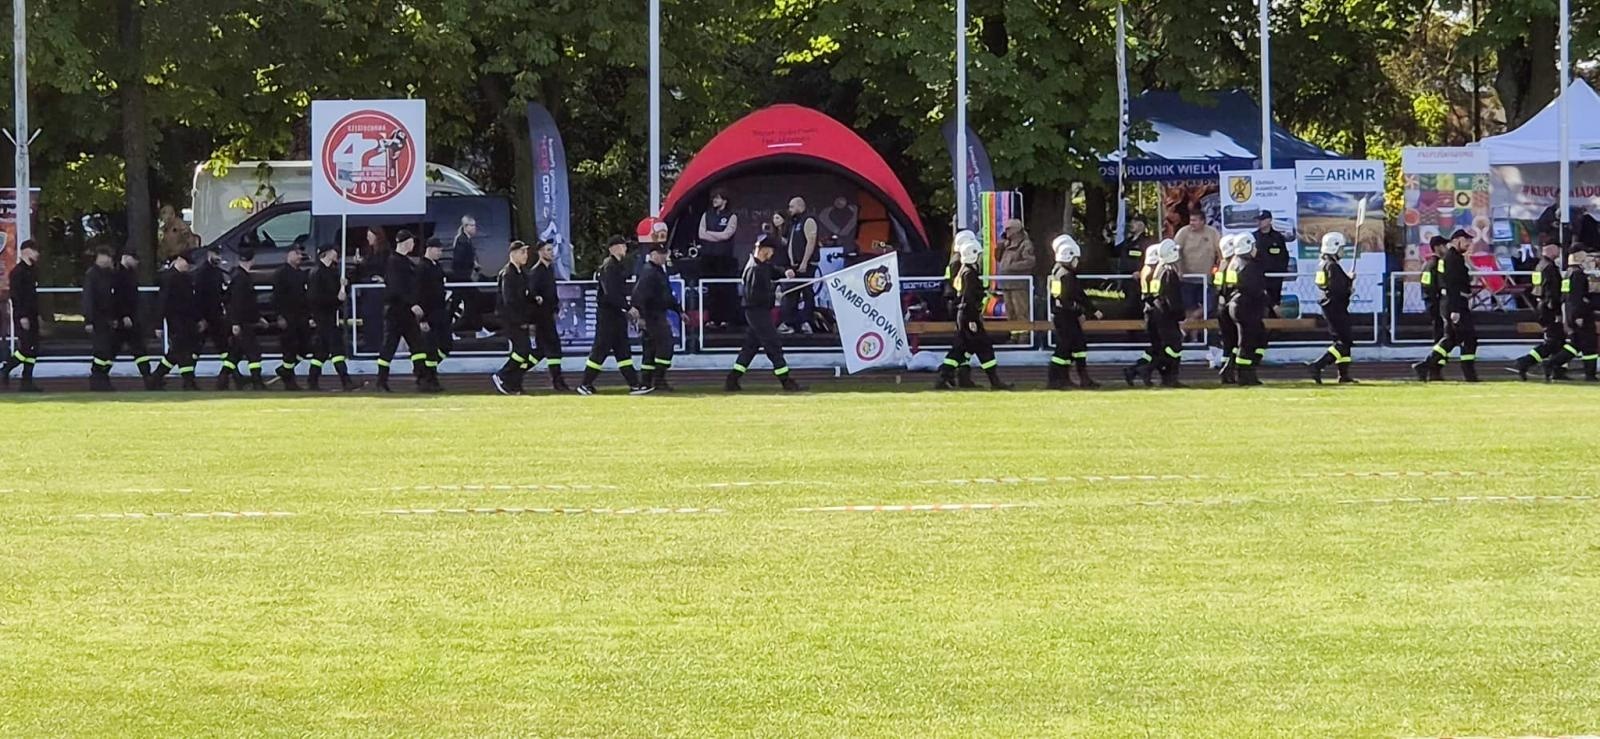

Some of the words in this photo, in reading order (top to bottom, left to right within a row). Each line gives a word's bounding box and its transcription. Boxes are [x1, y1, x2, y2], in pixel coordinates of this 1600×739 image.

[333, 133, 387, 172] 42
[1127, 164, 1175, 176] RUDNIK
[1177, 164, 1221, 175] WIELKI
[1326, 168, 1376, 181] ARiMR
[352, 181, 387, 195] 2026
